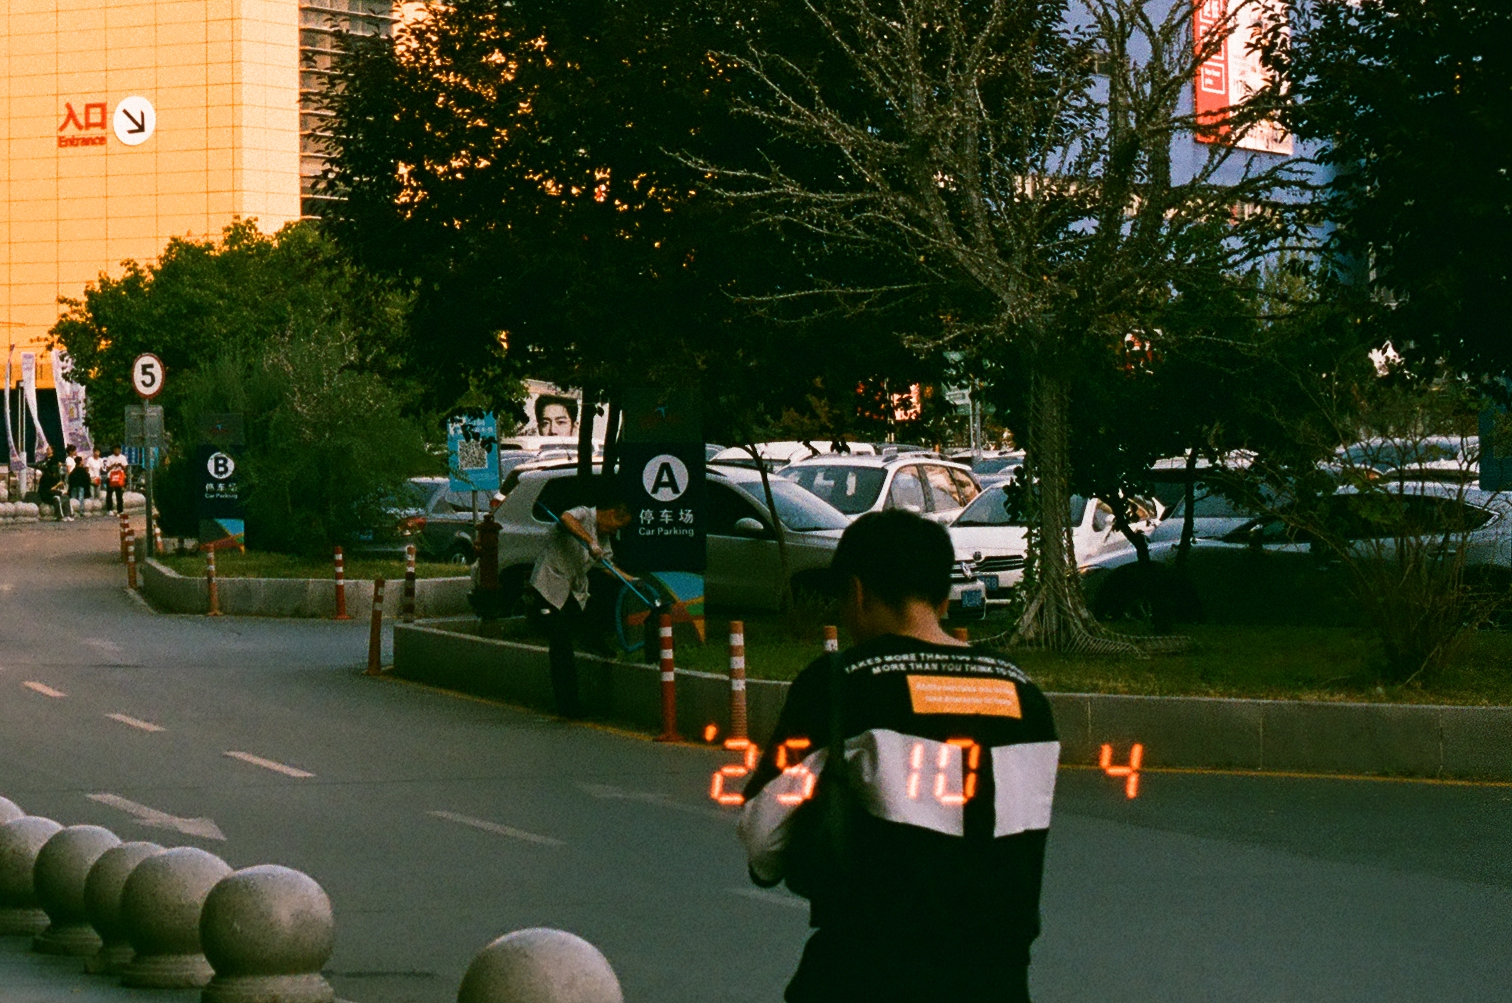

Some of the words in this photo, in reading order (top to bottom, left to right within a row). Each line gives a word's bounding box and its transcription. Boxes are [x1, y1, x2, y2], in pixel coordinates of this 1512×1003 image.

[58, 102, 107, 132] 入口
[57, 136, 107, 147] Entrance
[141, 363, 156, 388] 5
[214, 456, 229, 476] B
[651, 462, 681, 494] A
[639, 509, 694, 524] 停车场
[638, 527, 655, 536] Car
[657, 527, 695, 537] Parking
[872, 662, 907, 675] MORE
[909, 661, 939, 671] THAN
[941, 662, 963, 672] YOU
